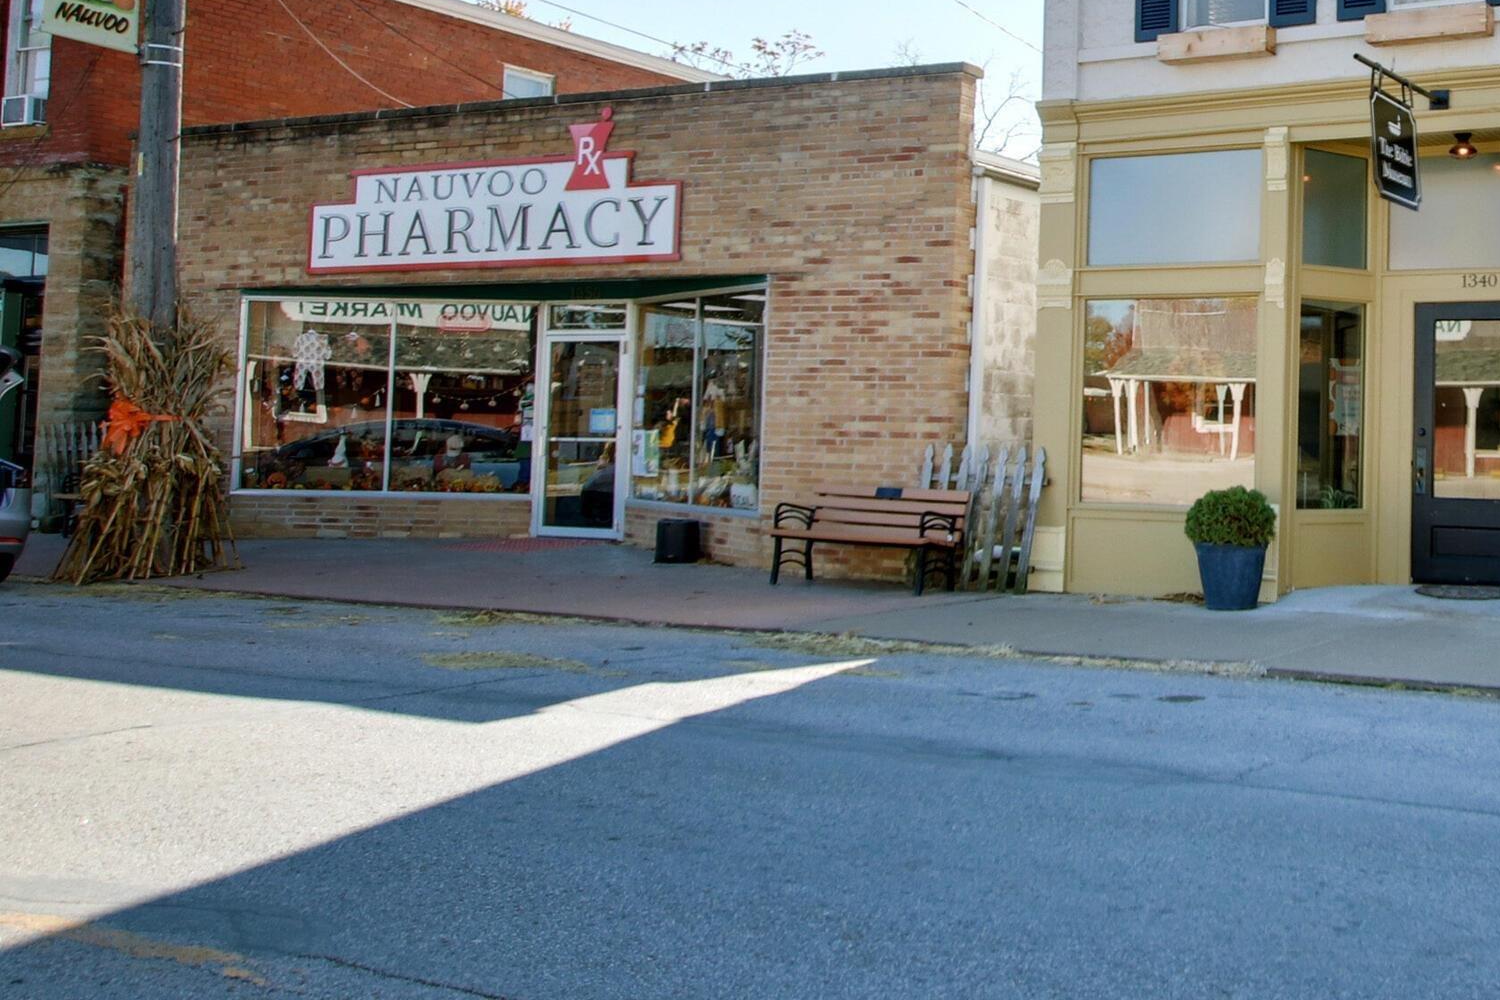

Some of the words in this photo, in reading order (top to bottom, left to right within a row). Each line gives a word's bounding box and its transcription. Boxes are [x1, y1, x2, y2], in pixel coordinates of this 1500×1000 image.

[55, 1, 130, 34] NAUVOO
[374, 168, 547, 204] NAUVOO
[318, 195, 668, 259] PHARMACY
[1461, 273, 1498, 288] 1340
